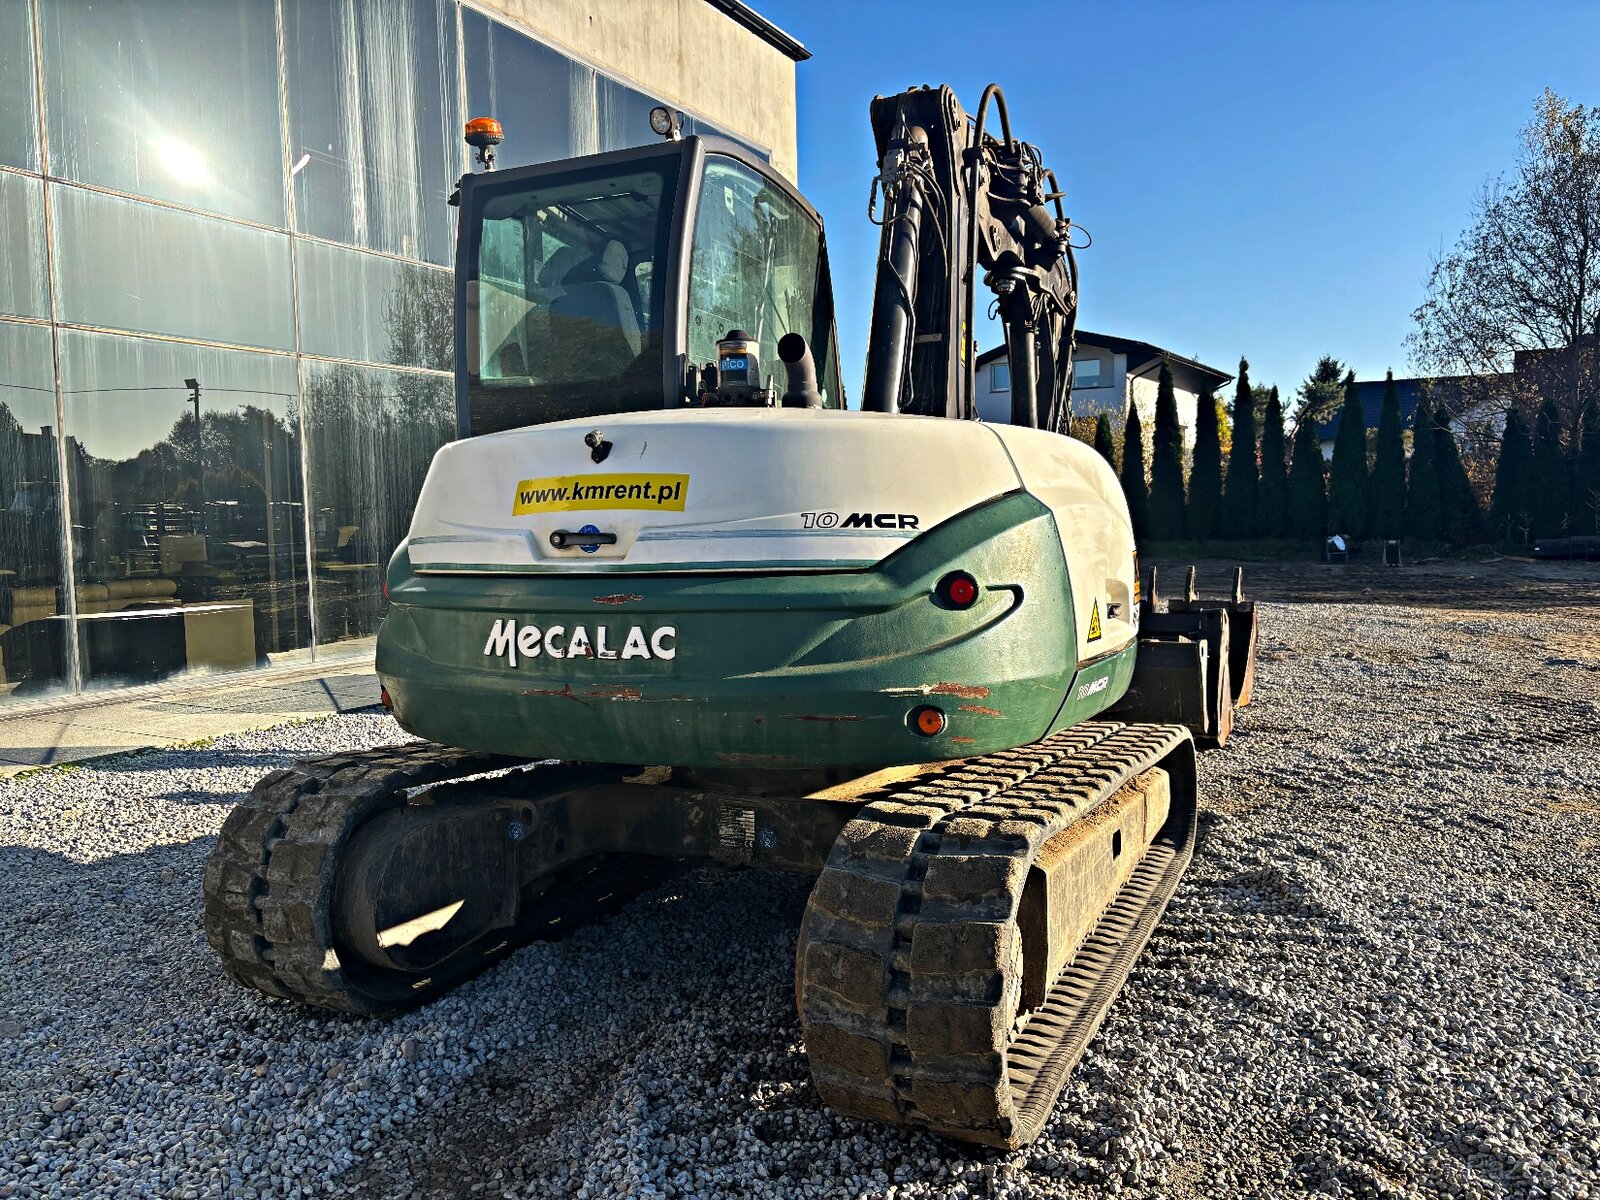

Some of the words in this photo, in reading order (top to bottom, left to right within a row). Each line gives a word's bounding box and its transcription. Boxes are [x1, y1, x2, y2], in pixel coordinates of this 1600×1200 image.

[520, 482, 681, 505] www.kmrent.pl
[801, 512, 839, 529] 10
[840, 513, 919, 530] MCR
[1087, 676, 1109, 696] MCR
